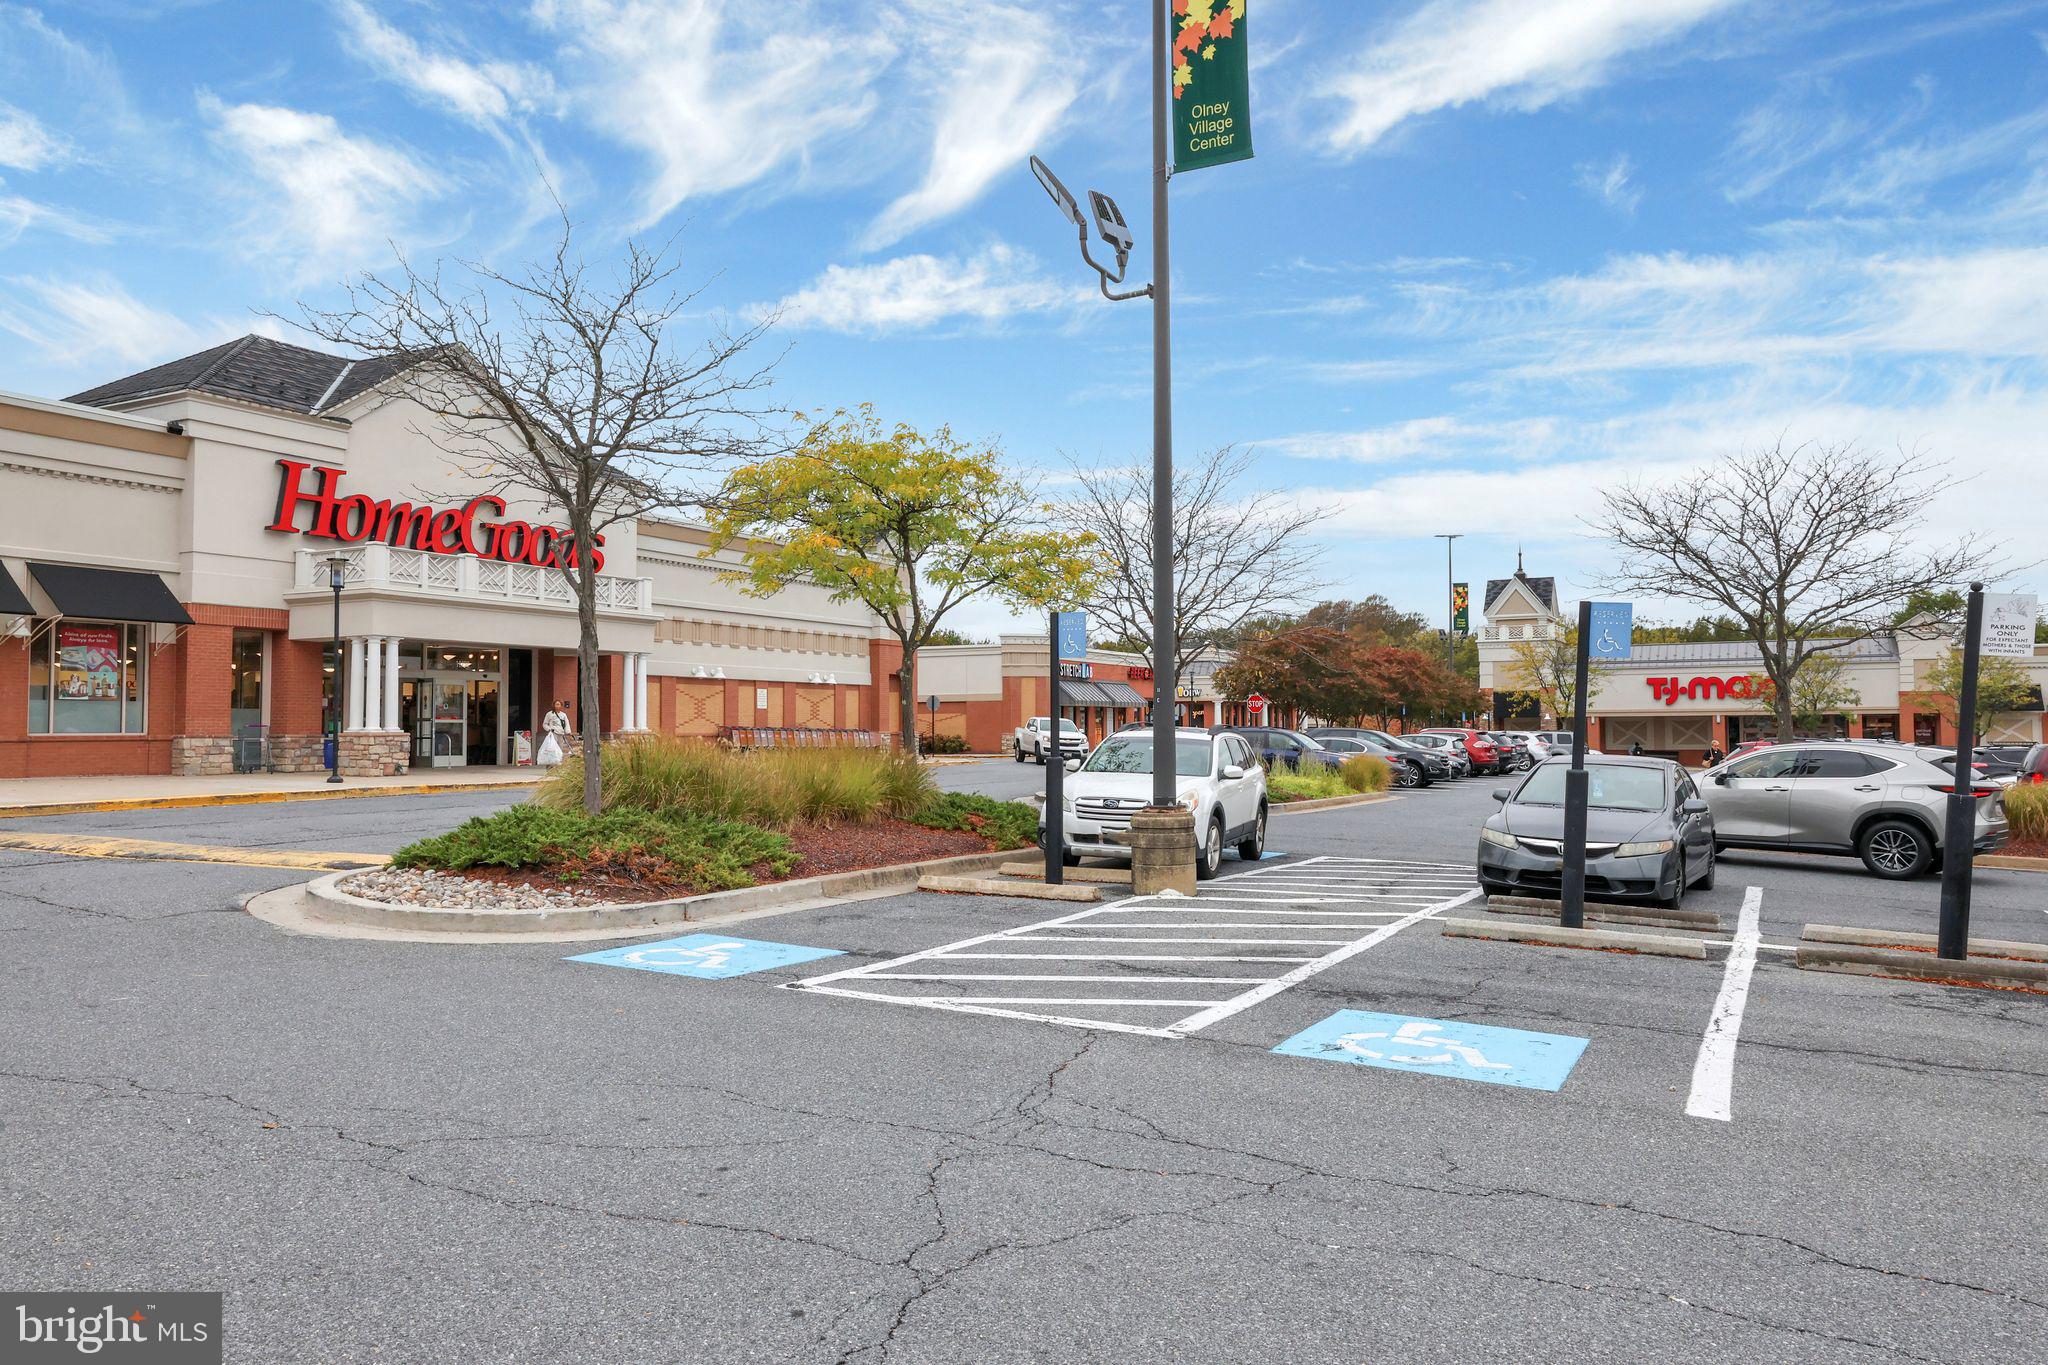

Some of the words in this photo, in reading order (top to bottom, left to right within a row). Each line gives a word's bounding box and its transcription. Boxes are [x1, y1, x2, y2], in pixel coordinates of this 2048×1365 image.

[1191, 101, 1230, 119] Olney
[1189, 117, 1233, 136] Village
[1189, 132, 1235, 152] Center
[1248, 700, 1263, 708] STOP
